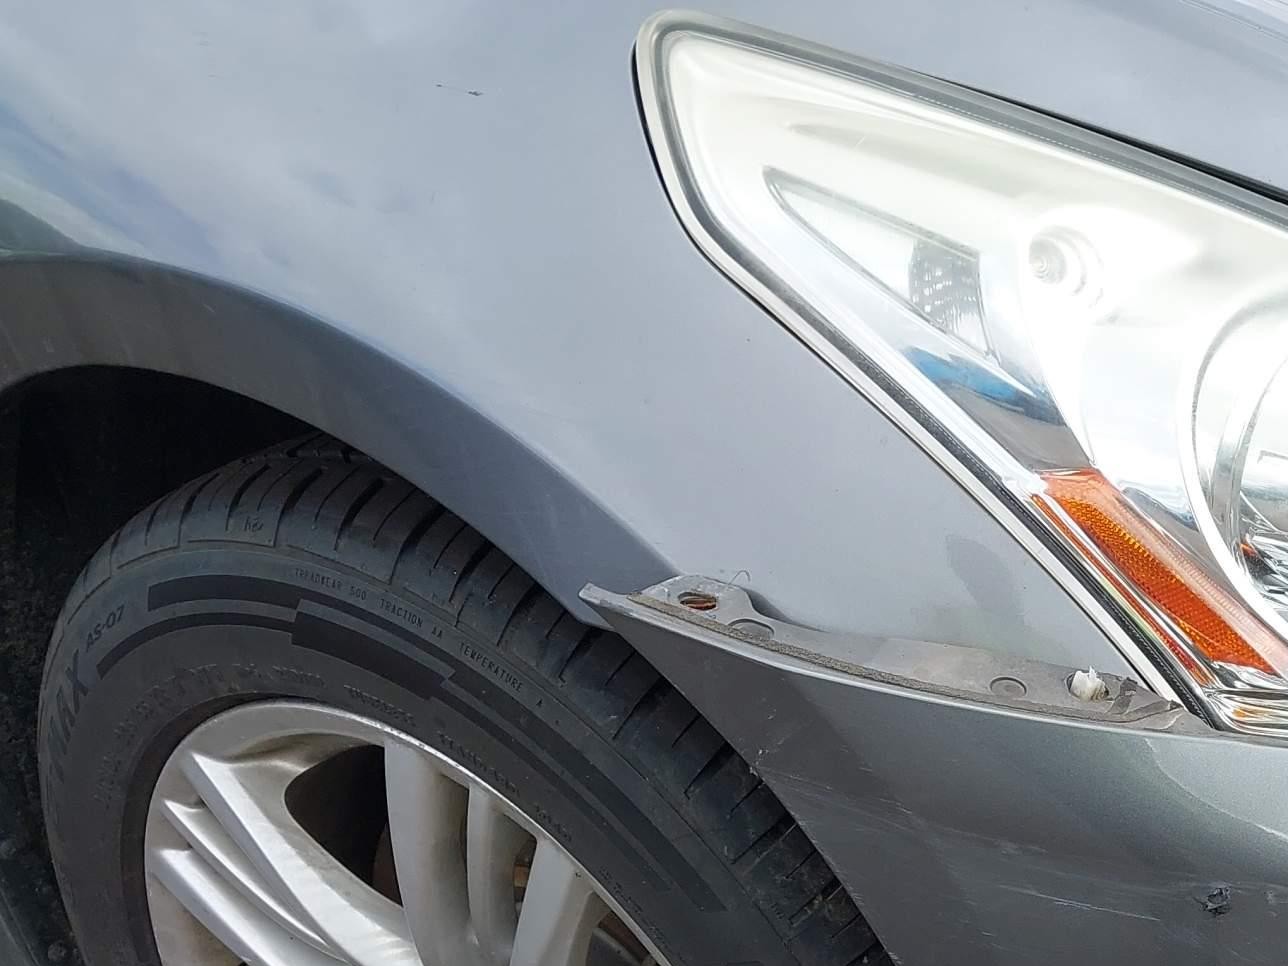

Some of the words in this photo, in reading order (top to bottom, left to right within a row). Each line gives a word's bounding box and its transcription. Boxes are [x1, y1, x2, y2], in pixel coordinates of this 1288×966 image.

[86, 604, 126, 652] AS-07
[379, 598, 424, 628] TRACTION
[459, 642, 523, 692] TEMPERATURE
